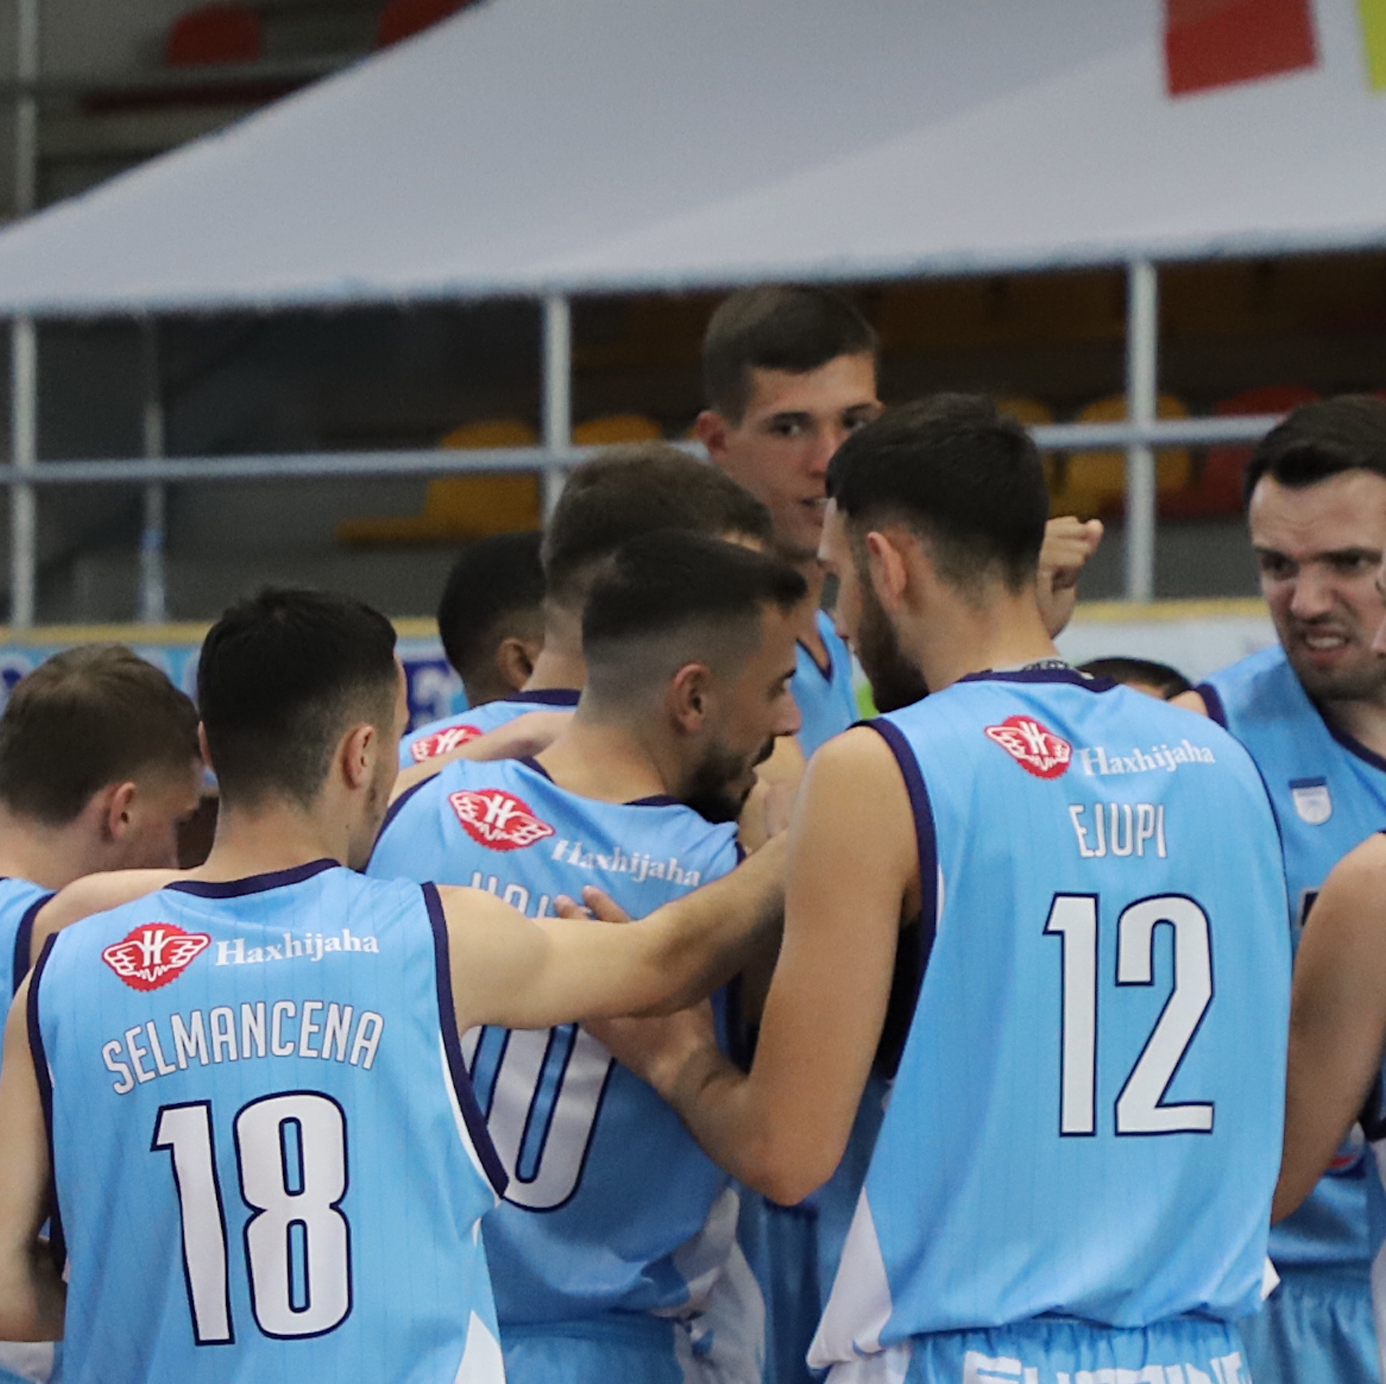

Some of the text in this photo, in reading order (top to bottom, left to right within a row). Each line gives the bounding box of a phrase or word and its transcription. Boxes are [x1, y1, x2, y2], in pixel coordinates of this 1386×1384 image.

[1080, 738, 1217, 778] Haxhijaha
[551, 838, 701, 887] Haxhijaha
[1068, 803, 1168, 859] EJUPI
[215, 928, 381, 967] Haxhijaha
[101, 999, 385, 1095] SELMANCENA
[1042, 892, 1215, 1137] 12
[456, 1023, 617, 1213] 0
[150, 1089, 354, 1346] 18
